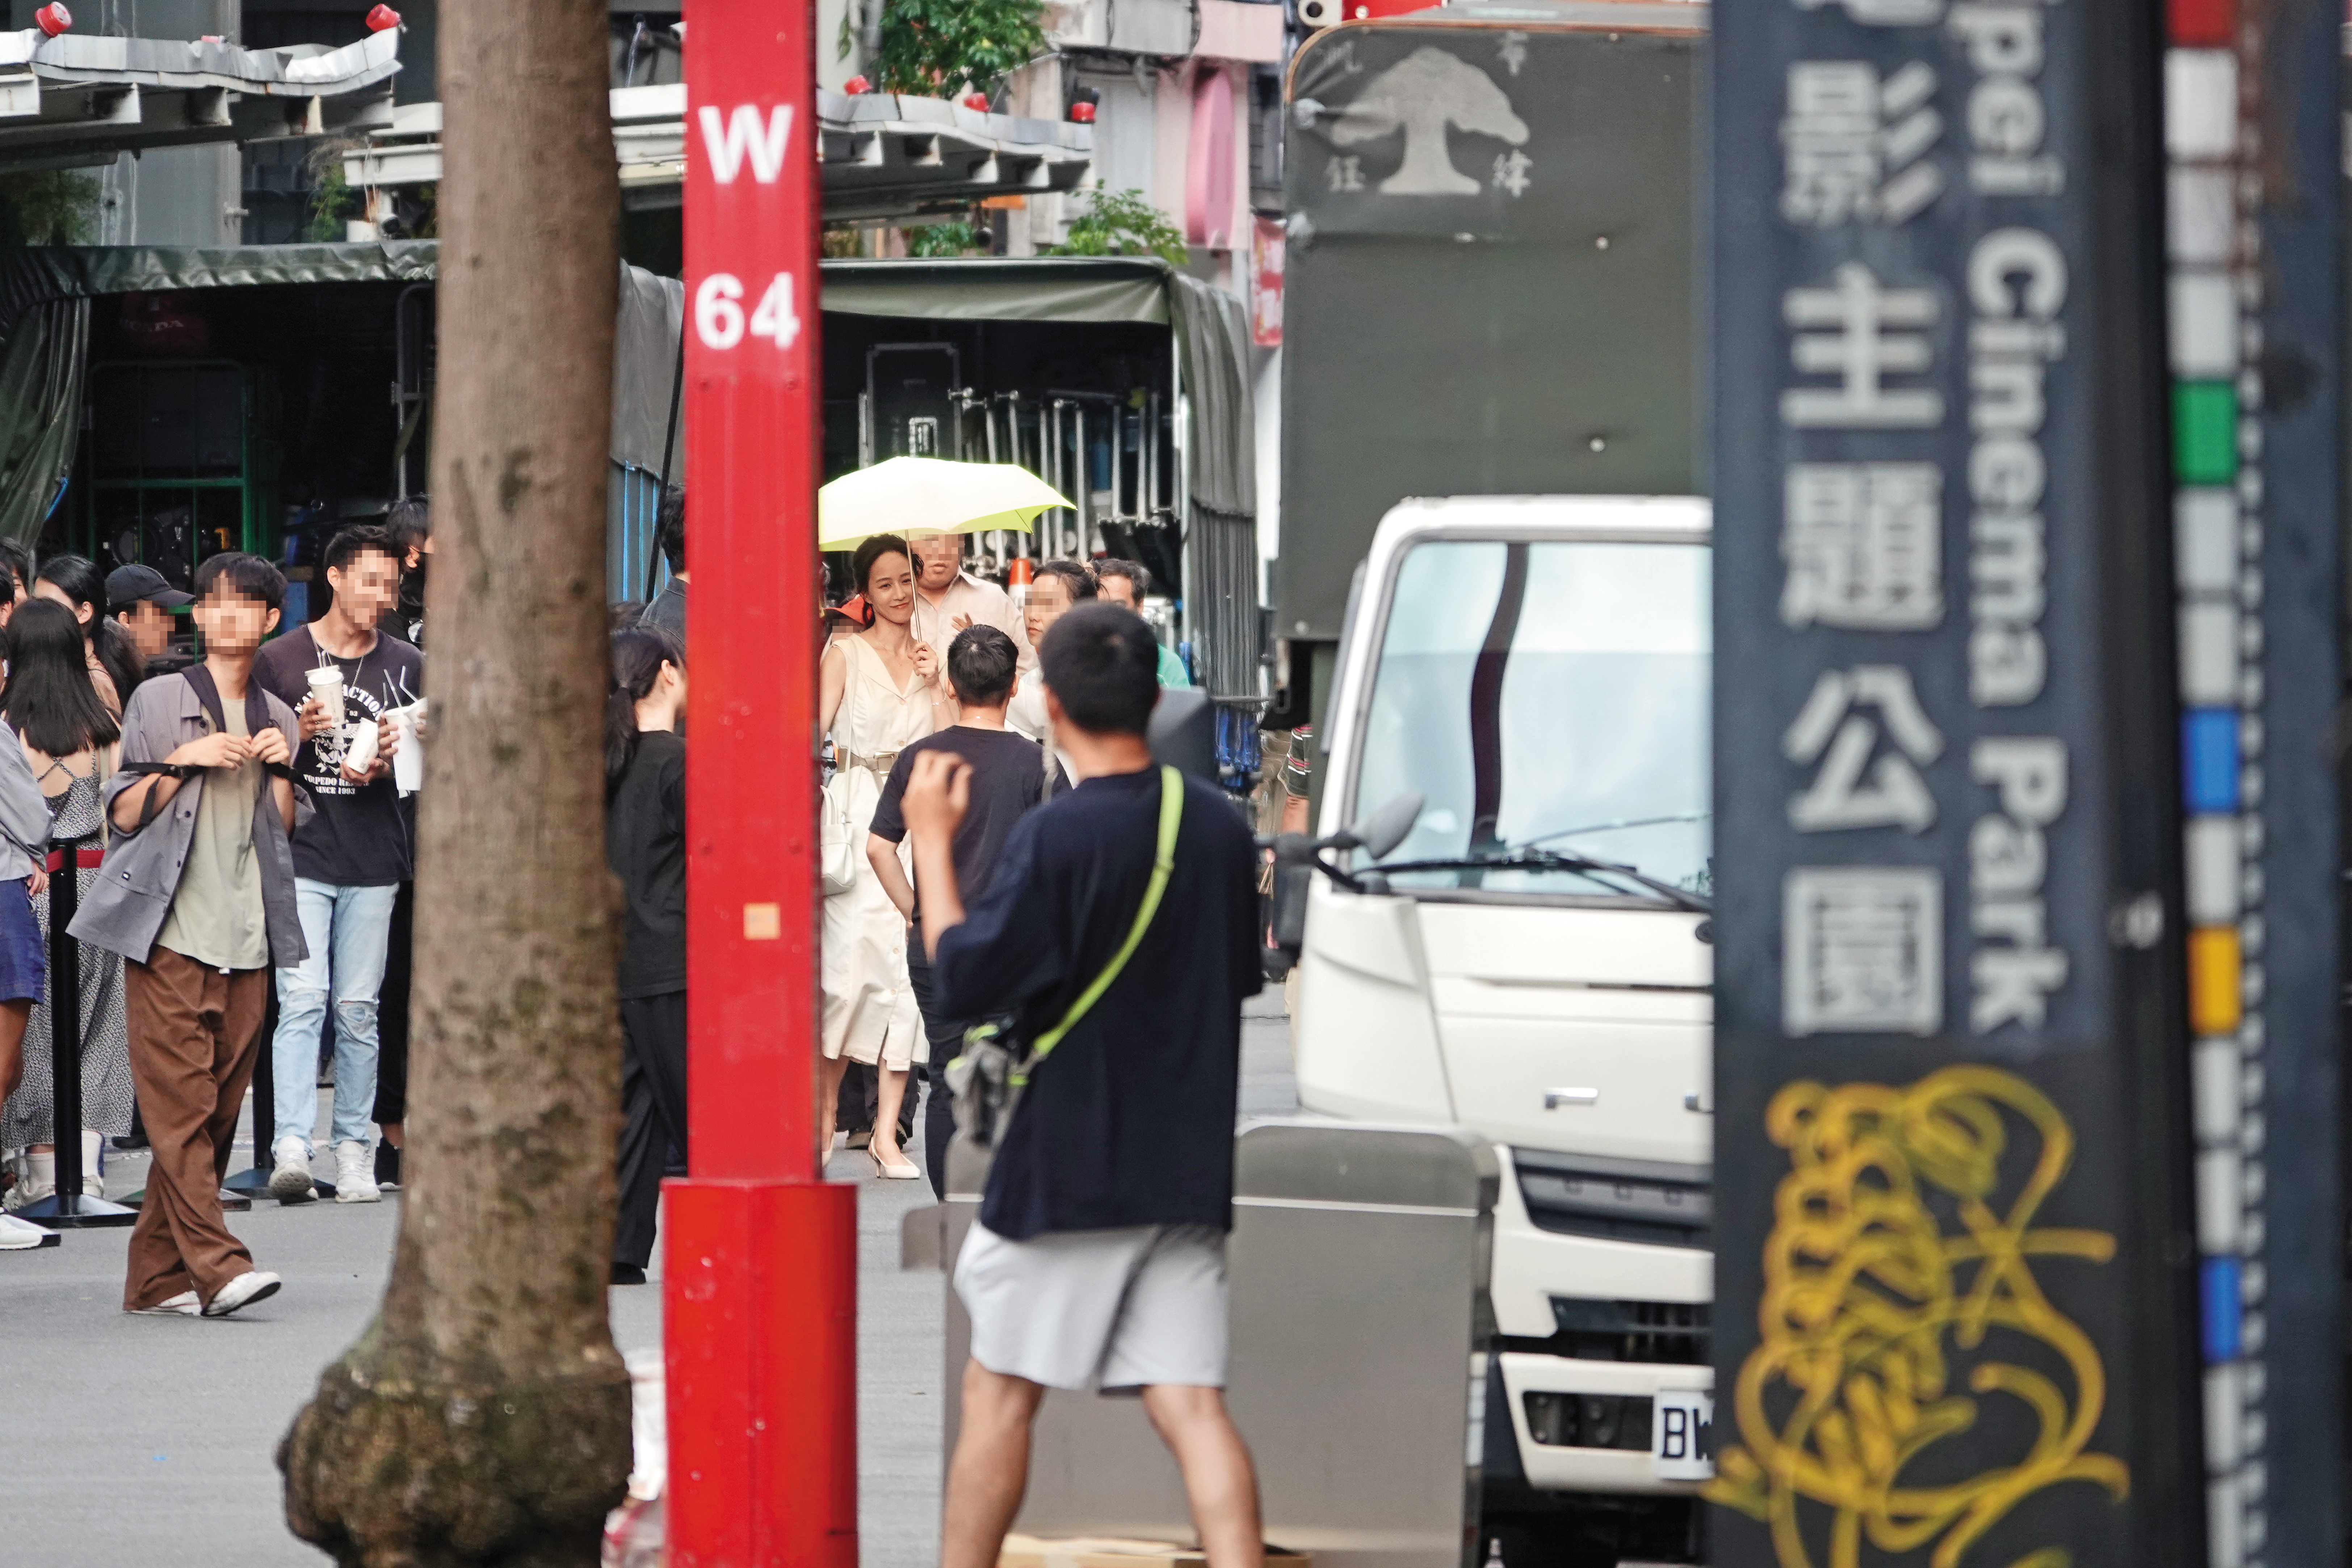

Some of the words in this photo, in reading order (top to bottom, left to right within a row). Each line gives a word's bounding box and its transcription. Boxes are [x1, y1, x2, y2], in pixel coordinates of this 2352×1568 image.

[698, 104, 794, 184] W
[1947, 0, 2067, 197] pei
[694, 272, 801, 350] 64
[1778, 0, 1946, 1038] 影主題公園
[1967, 227, 2069, 707] Cinema
[1967, 735, 2070, 1035] Park
